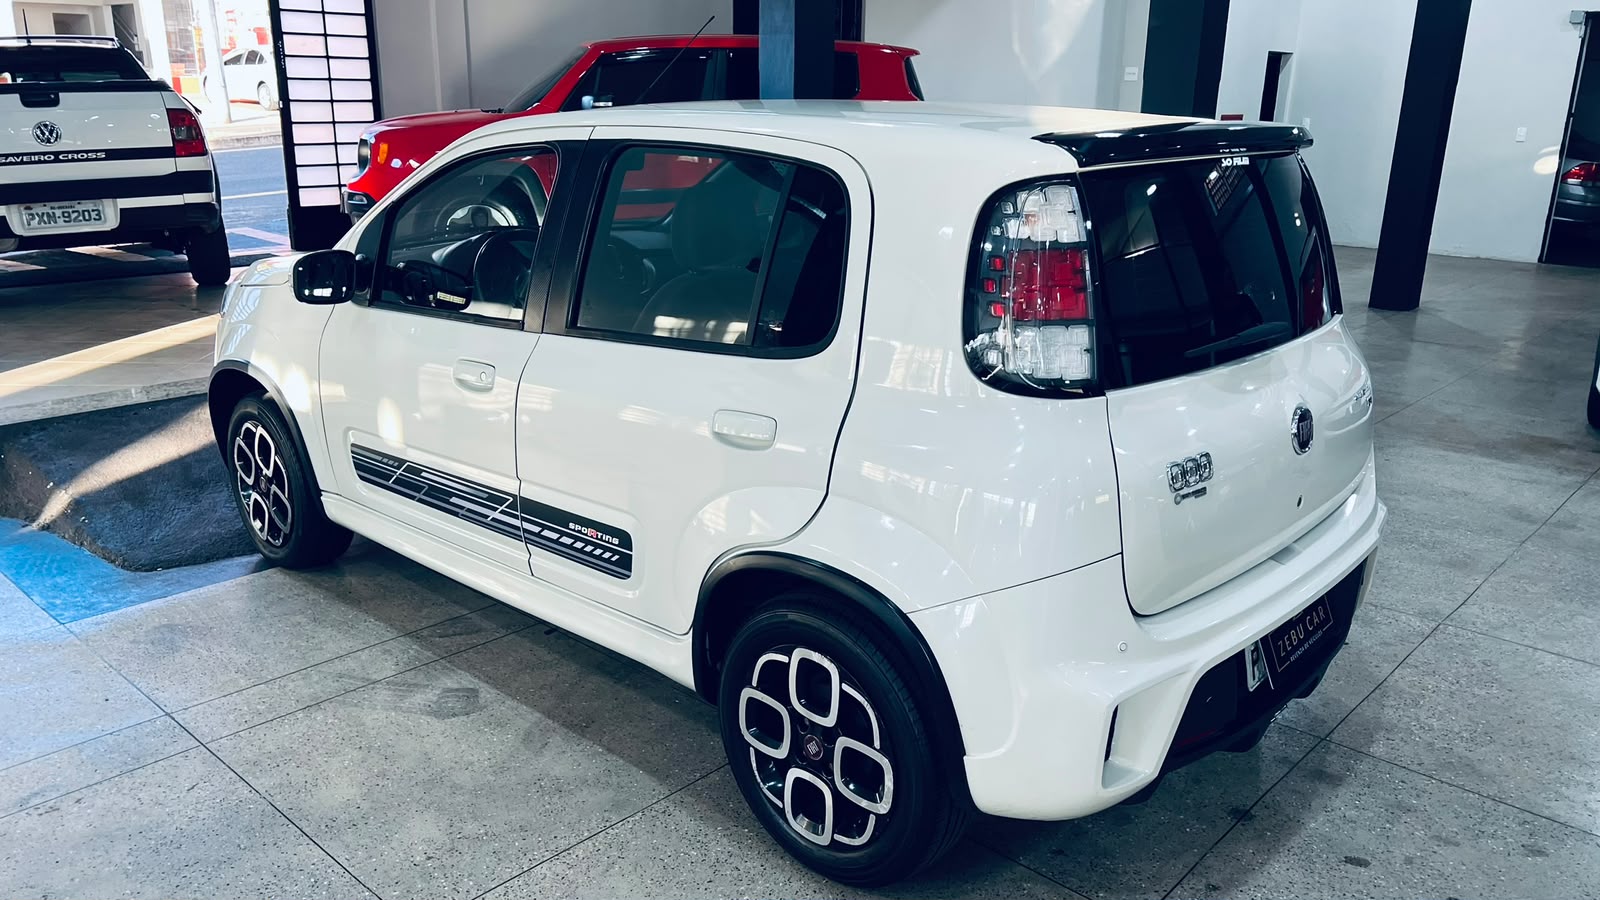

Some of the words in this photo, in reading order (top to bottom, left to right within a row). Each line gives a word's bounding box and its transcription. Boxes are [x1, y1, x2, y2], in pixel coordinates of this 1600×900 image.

[58, 152, 106, 160] CROSS
[568, 522, 620, 545] SPORTING
[1278, 623, 1305, 656] ZEBU
[1306, 605, 1326, 631] CAR
